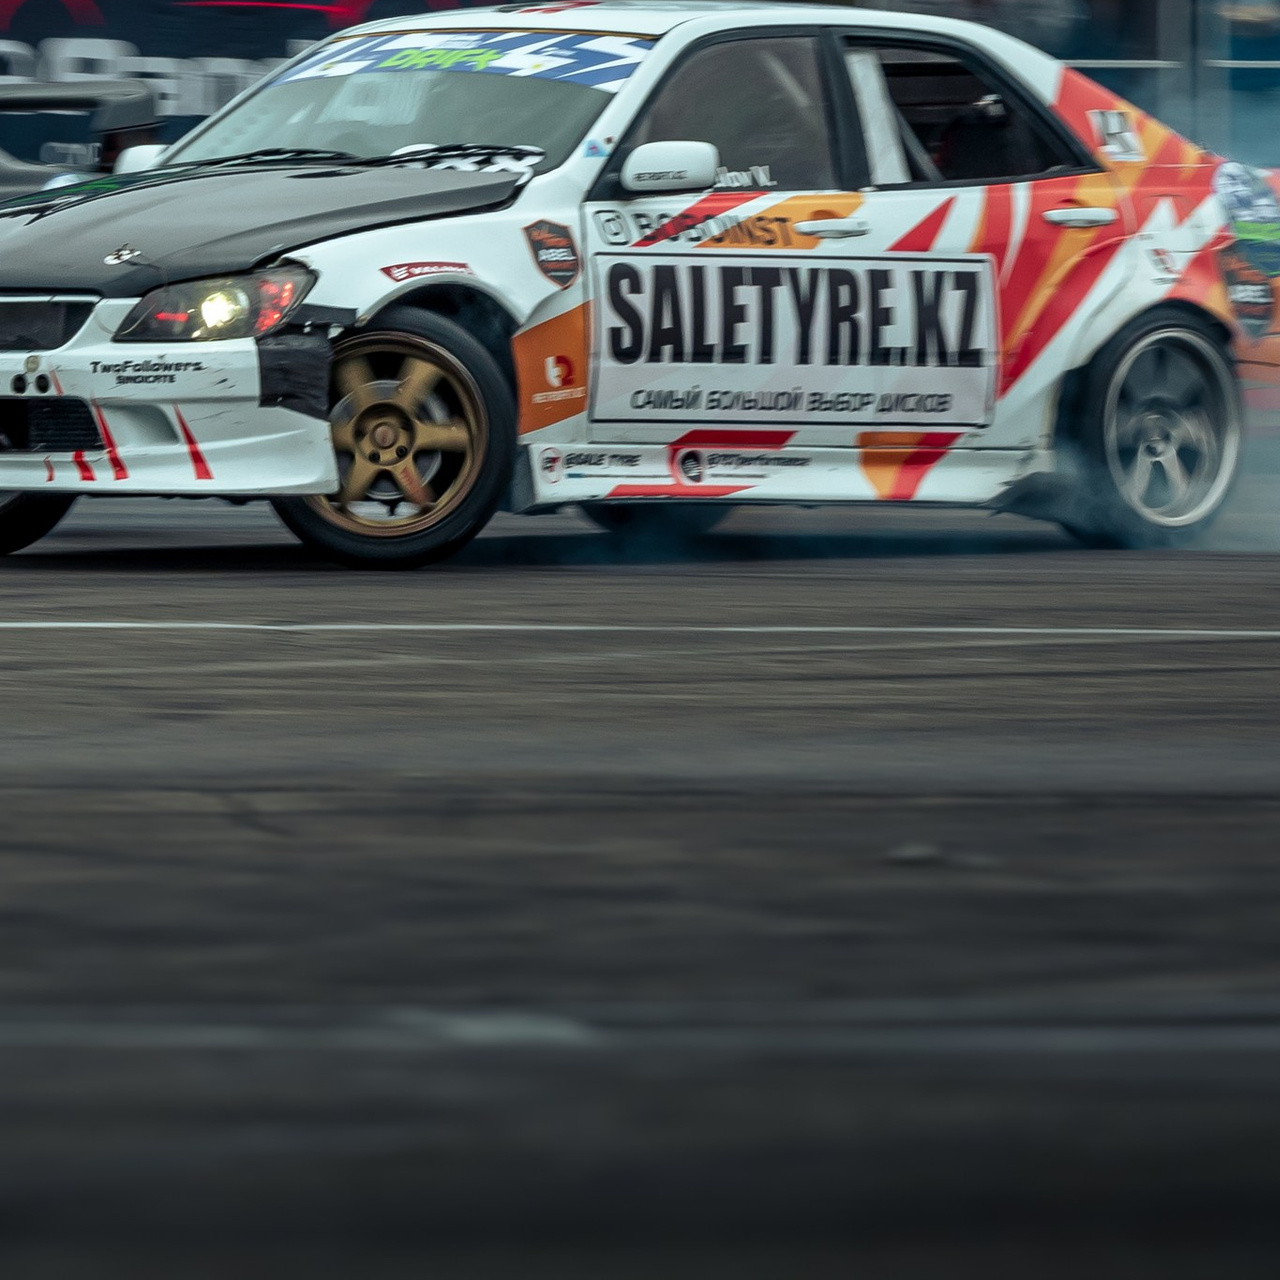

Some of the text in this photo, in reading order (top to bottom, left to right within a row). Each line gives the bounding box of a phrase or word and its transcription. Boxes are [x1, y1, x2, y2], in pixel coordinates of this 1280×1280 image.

[607, 262, 984, 367] SALETYRE.KZ
[629, 385, 953, 413] САМЫЙ БОЛЬШОЙ ВЫБОР ДИСКОВ
